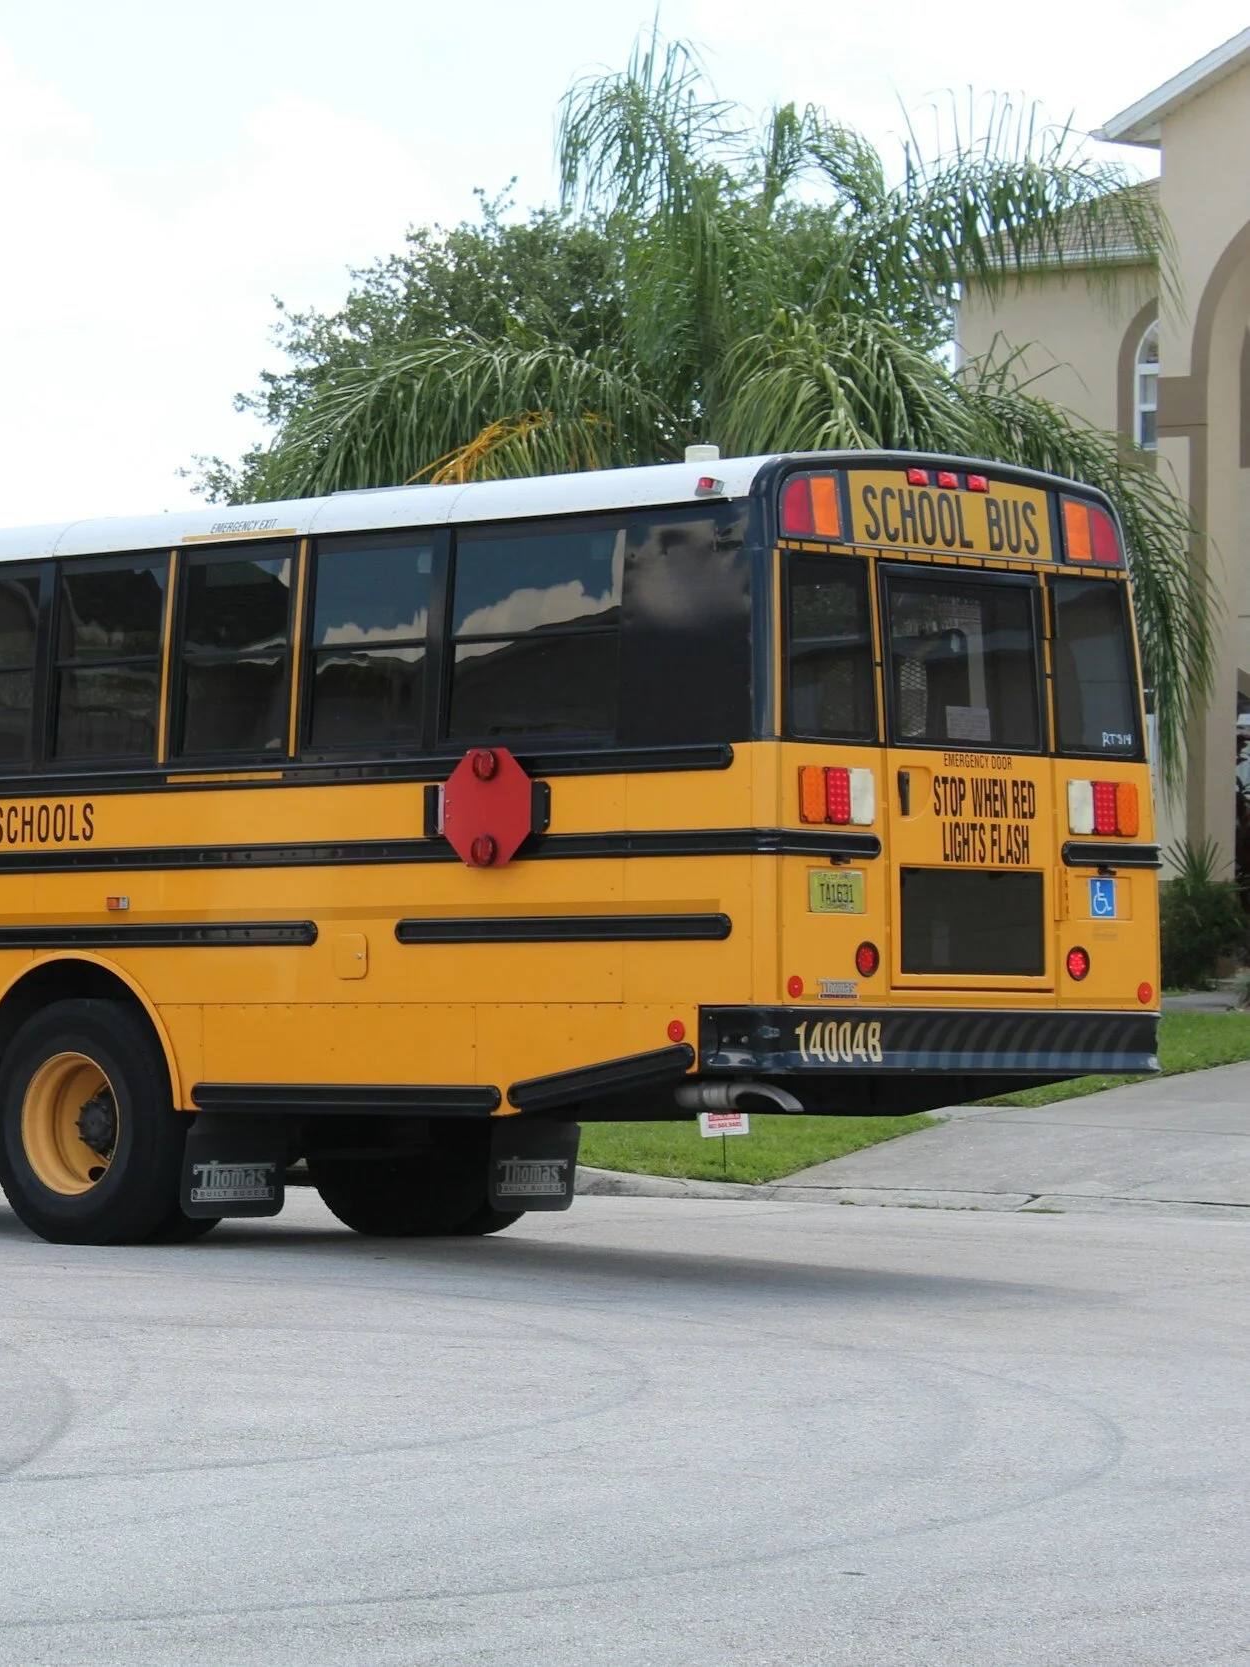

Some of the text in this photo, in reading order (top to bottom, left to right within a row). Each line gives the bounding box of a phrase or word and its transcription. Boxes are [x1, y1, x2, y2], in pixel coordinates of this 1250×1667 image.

[210, 518, 278, 534] EMERGENCY EXIT
[862, 484, 1040, 556] SCHOOL BUS
[943, 753, 1013, 770] EMERGENCY DOOR
[933, 775, 1036, 819] STOP WHEN RED
[942, 821, 1030, 864] LIGHTS FLASH
[819, 883, 855, 903] TA1631
[794, 1021, 883, 1063] 14004B
[193, 1160, 276, 1188] Thomas
[497, 1155, 568, 1182] Thomas
[200, 1189, 266, 1198] BUILT BUSES
